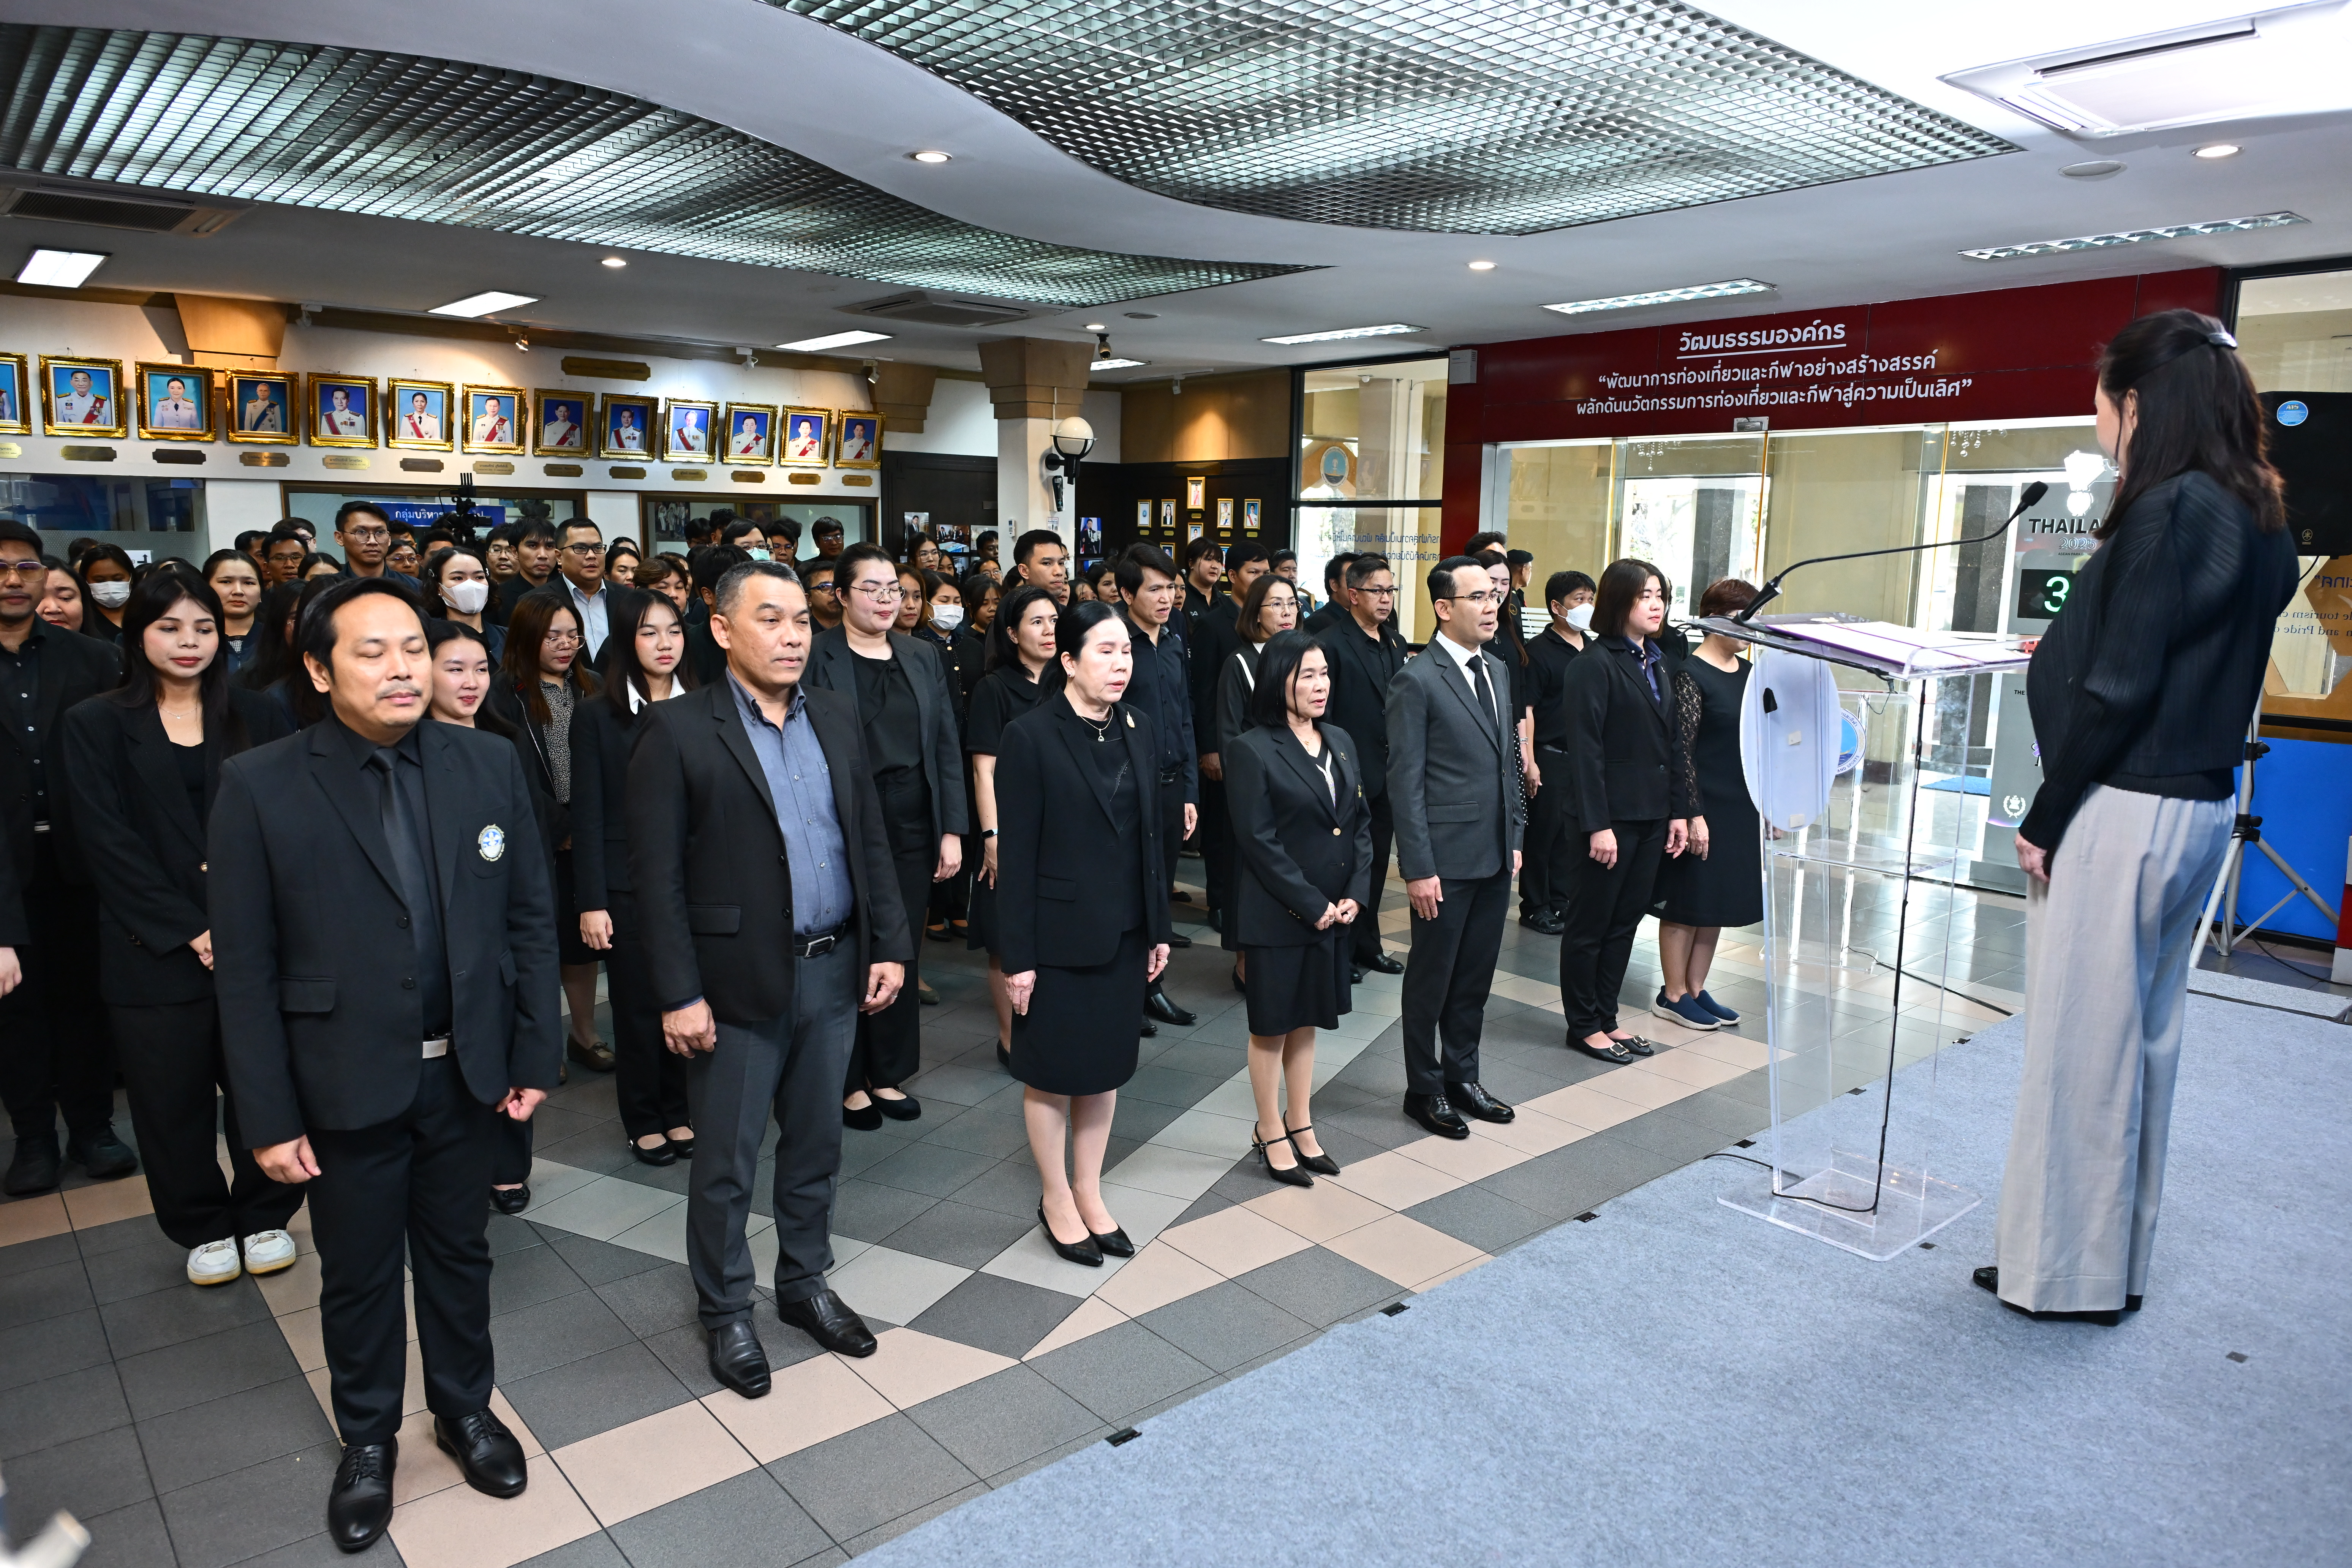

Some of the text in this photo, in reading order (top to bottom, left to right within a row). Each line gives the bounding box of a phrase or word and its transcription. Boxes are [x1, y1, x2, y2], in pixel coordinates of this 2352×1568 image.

[1679, 319, 1845, 351] วัฒนธรรมองค์กร
[1598, 349, 1938, 389] “พัฒนาการท่องเที่ยวและกีฬาอย่างสร้างสรรค์
[1577, 376, 1972, 415] ผลักดันนวัตกรรมการท่องเที่ยวและกีฬาสู่ความเป็นเลิศ”
[2028, 518, 2105, 534] THAILA
[2059, 537, 2097, 550] 2025
[2044, 576, 2069, 612] 3
[1846, 755, 1860, 768] SPORTS
